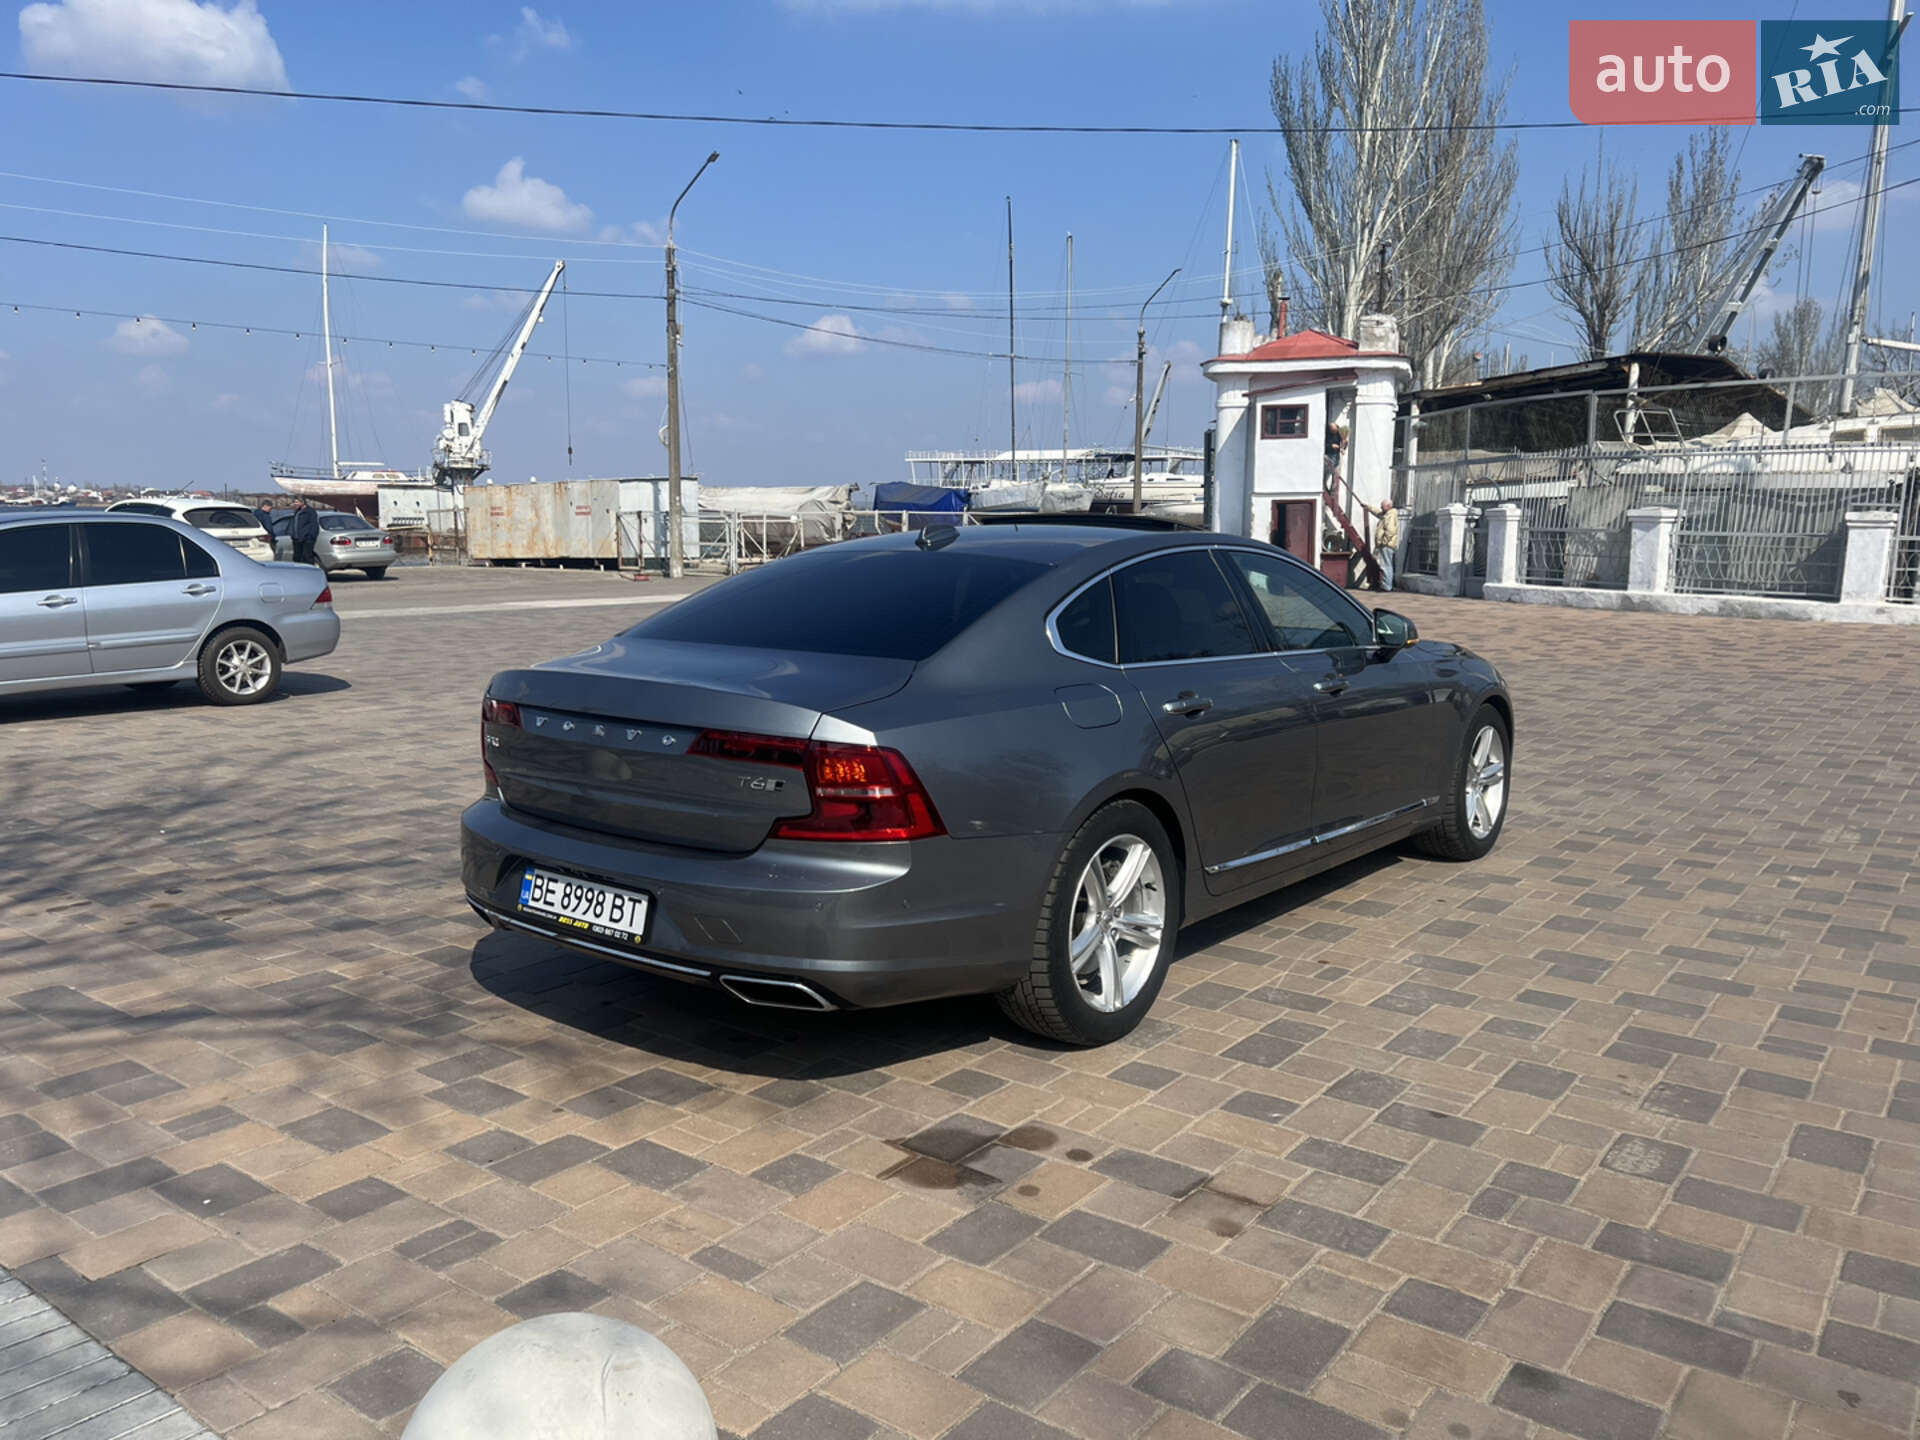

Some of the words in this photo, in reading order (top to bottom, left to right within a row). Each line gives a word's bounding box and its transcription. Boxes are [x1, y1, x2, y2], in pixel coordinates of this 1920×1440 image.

[535, 716, 677, 746] VOLVO
[531, 875, 558, 907] BE
[561, 882, 606, 919] 8998
[609, 893, 642, 927] BT
